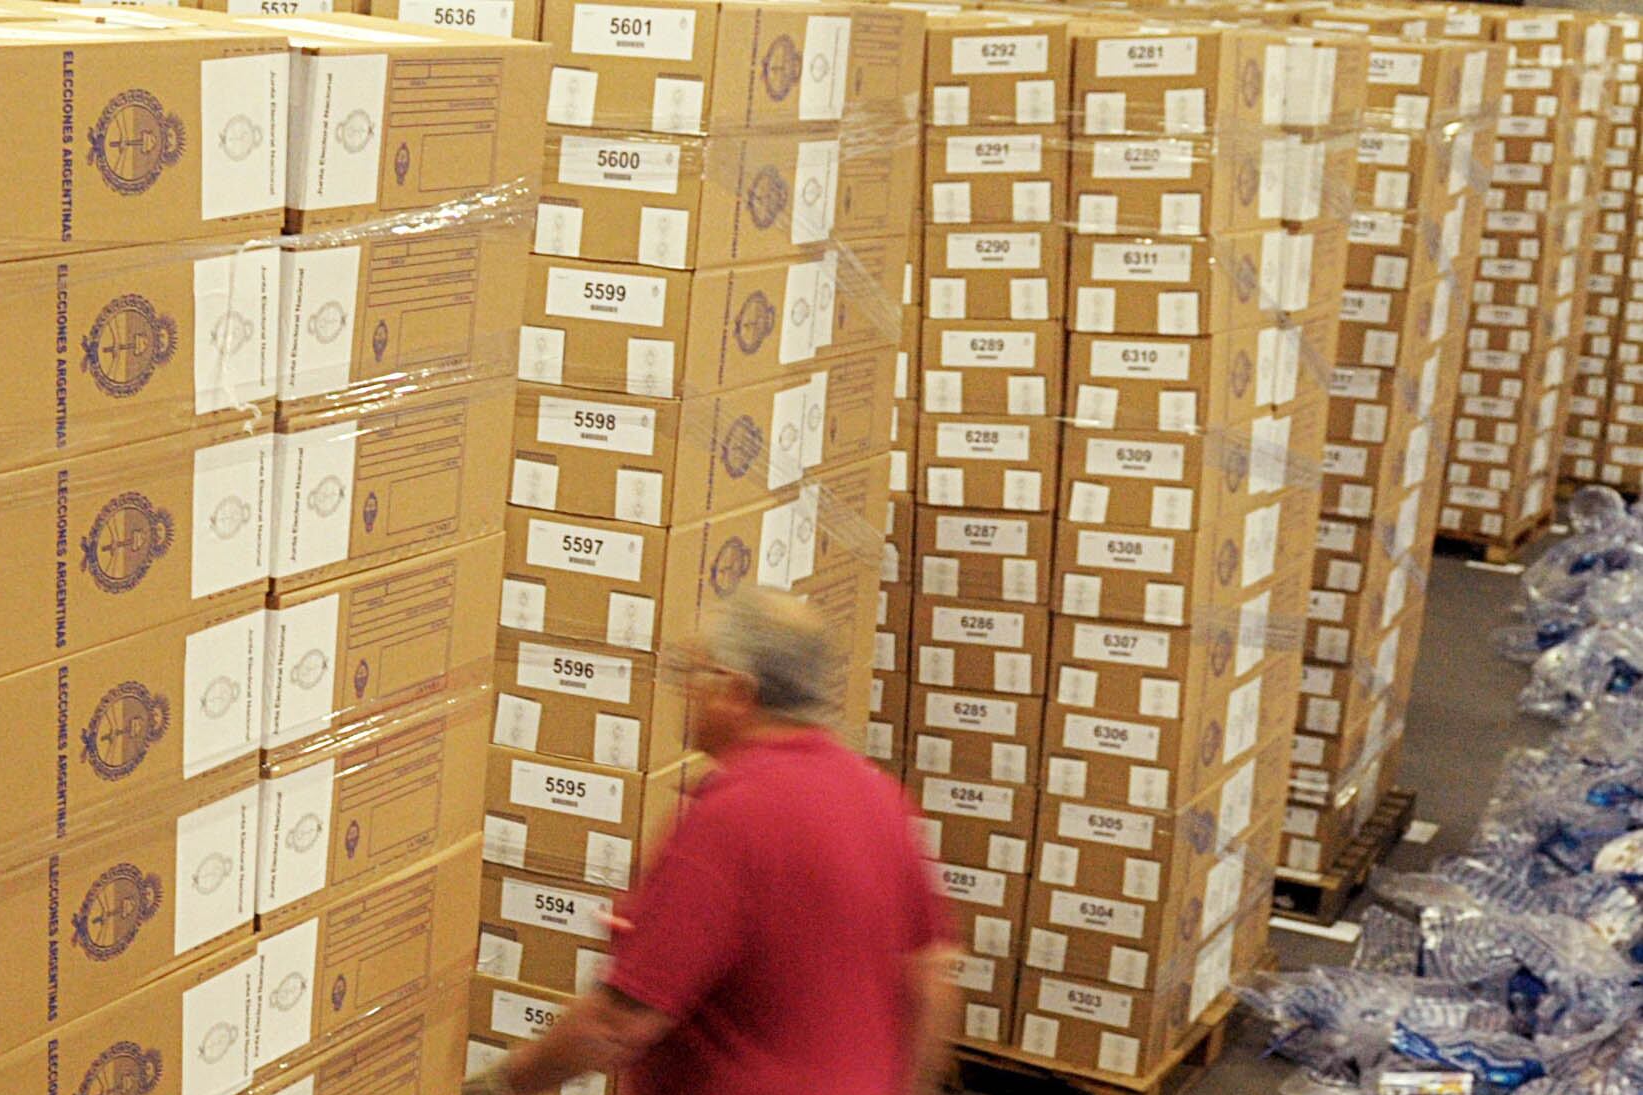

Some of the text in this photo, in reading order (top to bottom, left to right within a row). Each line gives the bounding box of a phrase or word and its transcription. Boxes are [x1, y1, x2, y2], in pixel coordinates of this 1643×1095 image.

[434, 8, 476, 26] 5636
[610, 18, 652, 37] 5601
[981, 44, 1016, 57] 6292
[1128, 46, 1164, 59] 6281
[61, 51, 74, 242] ELECCIONES ARGENTINAS
[597, 150, 640, 170] 5600
[976, 240, 1009, 254] 6290
[1124, 252, 1157, 266] 6311
[583, 282, 626, 302] 5599
[56, 264, 68, 354] ELECCIONES
[970, 339, 1004, 352] 6289
[1122, 350, 1157, 364] 6310
[574, 410, 616, 431] 5598
[965, 431, 999, 444] 6288
[1116, 449, 1152, 463] 6309
[964, 525, 997, 539] 6287
[562, 535, 604, 555] 5597
[56, 470, 68, 648] ELECCIONES ARGENTINAS
[960, 616, 994, 630] 6286
[553, 657, 594, 678] 5596
[58, 666, 68, 750] ELECCIONES
[954, 703, 987, 718] 6285
[1094, 725, 1128, 742] 6306
[545, 776, 586, 798] 5595
[951, 787, 983, 803] 6284
[1088, 815, 1123, 831] 6305
[48, 856, 59, 936] ELECCIONES
[535, 894, 575, 915] 5594
[1079, 903, 1113, 919] 6304
[1068, 991, 1102, 1008] 6303
[524, 1007, 558, 1027] 559
